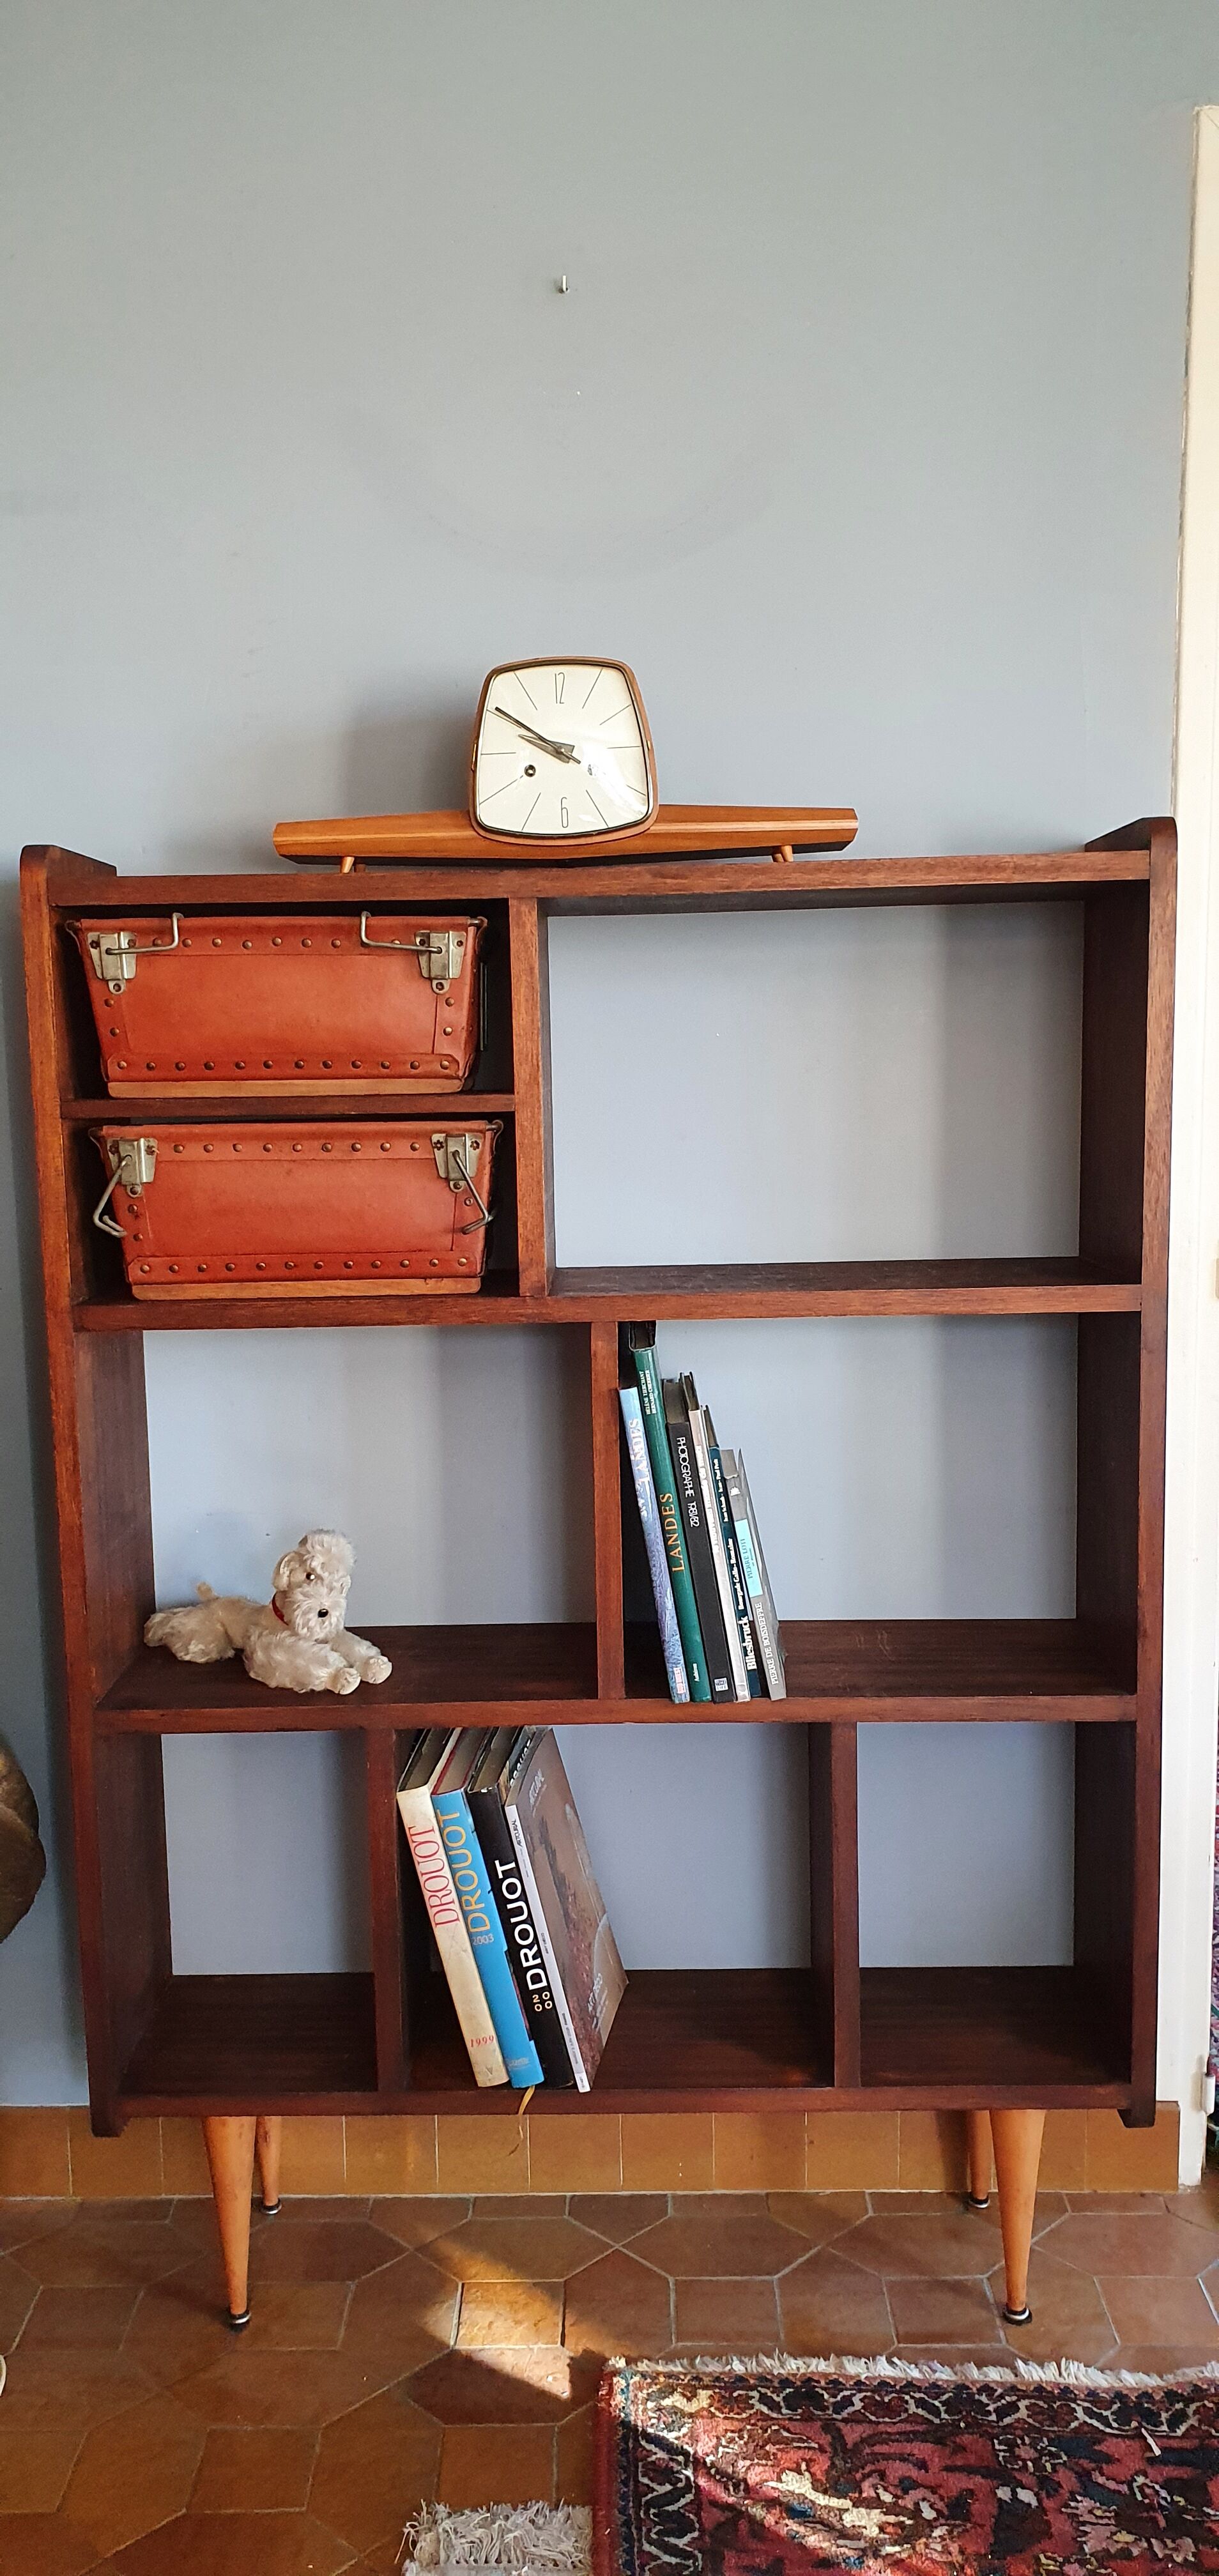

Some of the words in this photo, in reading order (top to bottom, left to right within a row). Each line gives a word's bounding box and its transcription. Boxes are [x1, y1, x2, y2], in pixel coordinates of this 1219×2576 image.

[555, 672, 565, 704] 12
[561, 797, 568, 829] 6
[629, 1418, 650, 1483] LANDES
[687, 1501, 700, 1528] 1981/82
[659, 1493, 685, 1572] LANDES
[740, 1538, 748, 1554] LOTI
[744, 1555, 753, 1579] PIERRE
[765, 1647, 773, 1659] DE
[767, 1659, 779, 1685] PIERRE
[408, 1825, 461, 1928] DROUOT
[436, 1809, 491, 1932] DROUOT
[471, 1934, 494, 1945] 2003
[494, 1859, 548, 1991] DROUOT
[470, 2035, 494, 2048] 1999
